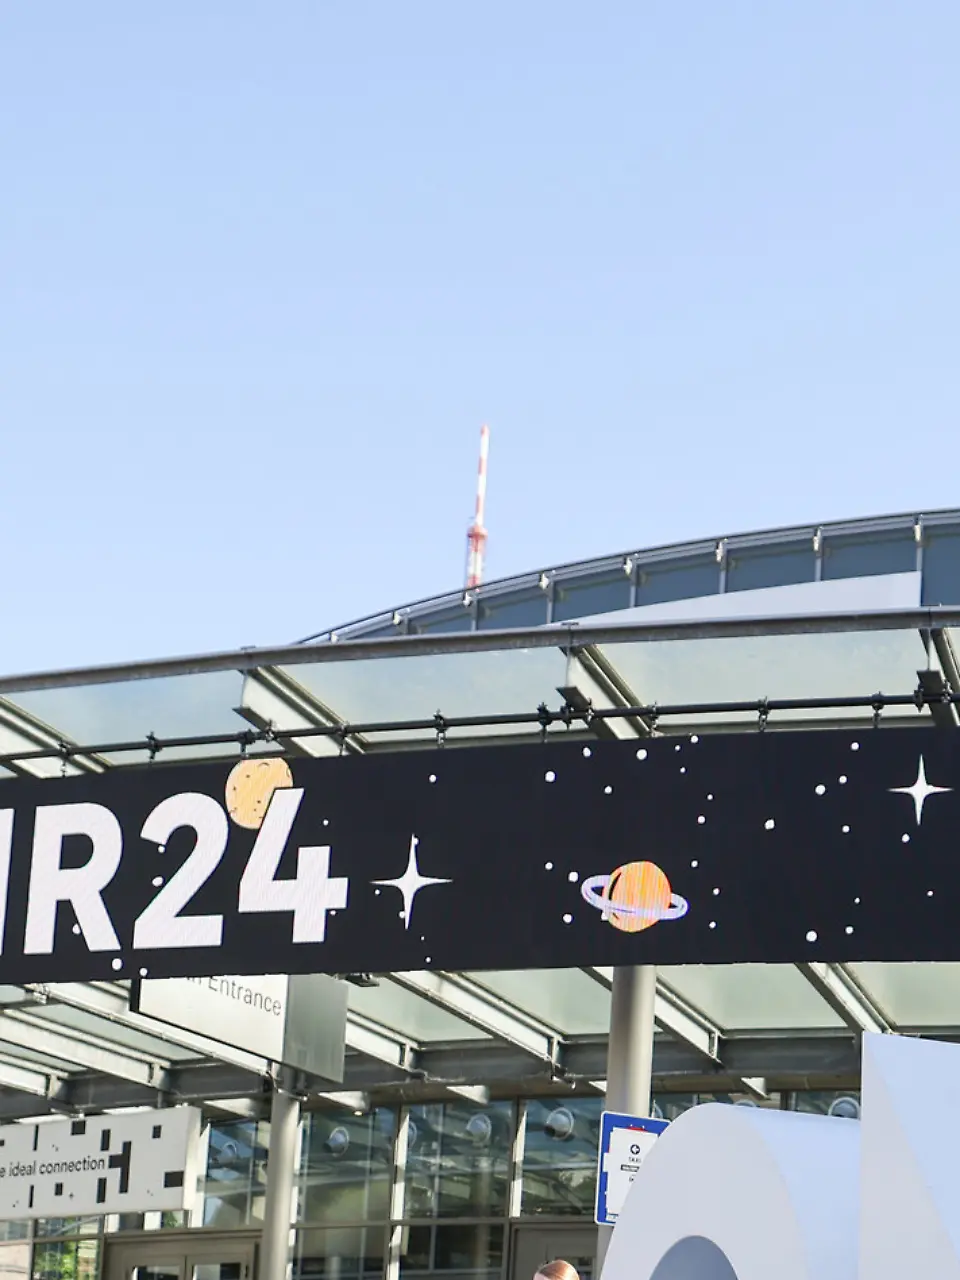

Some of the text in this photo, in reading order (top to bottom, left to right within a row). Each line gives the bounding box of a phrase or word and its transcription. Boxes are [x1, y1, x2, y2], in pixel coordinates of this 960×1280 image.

[208, 976, 282, 1016] Entrance
[9, 1160, 36, 1177] ideal
[39, 1155, 105, 1175] connection
